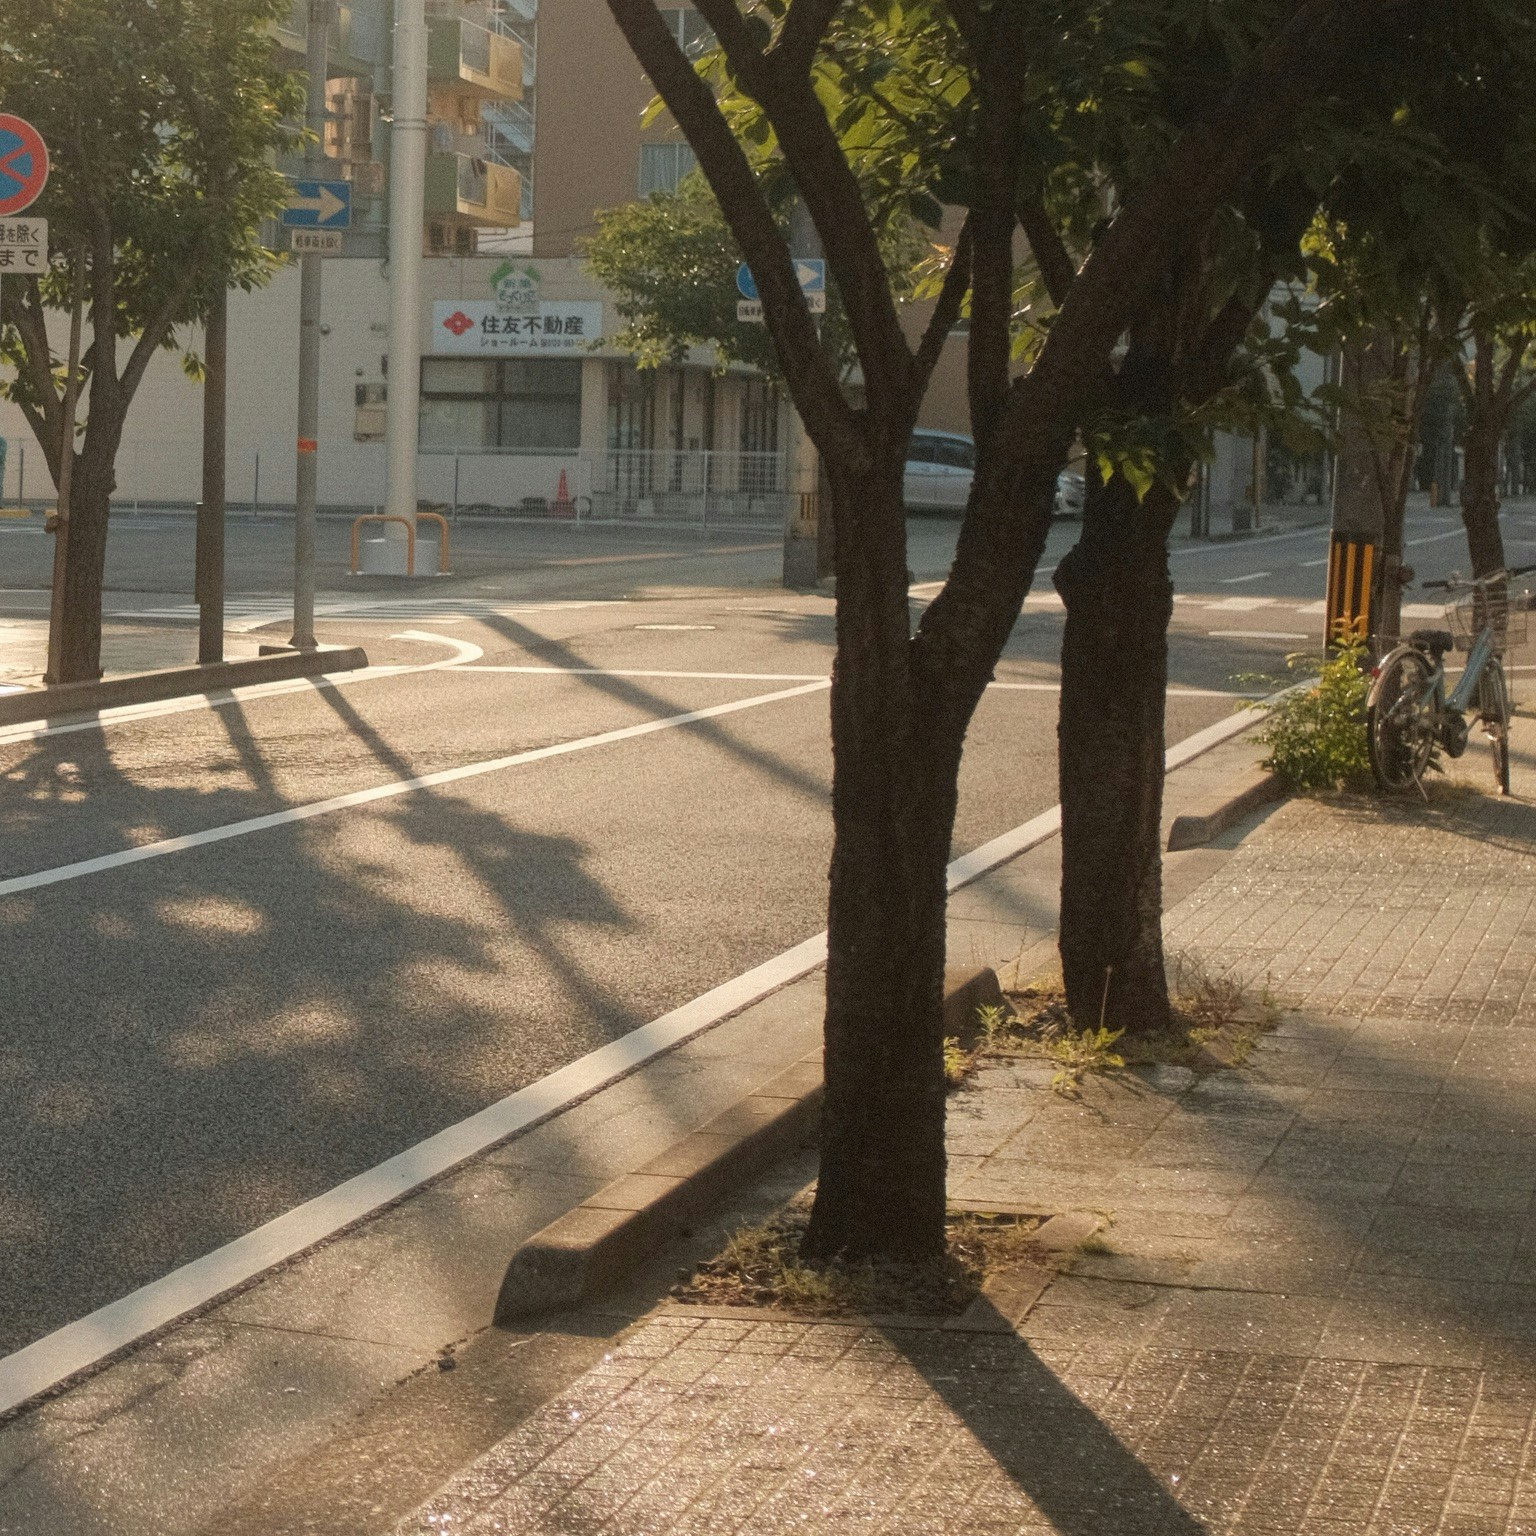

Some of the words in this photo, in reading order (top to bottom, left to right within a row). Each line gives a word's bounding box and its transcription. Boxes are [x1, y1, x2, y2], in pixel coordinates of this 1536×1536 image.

[481, 315, 584, 336] 住友不動産
[480, 338, 539, 348] ショールーム
